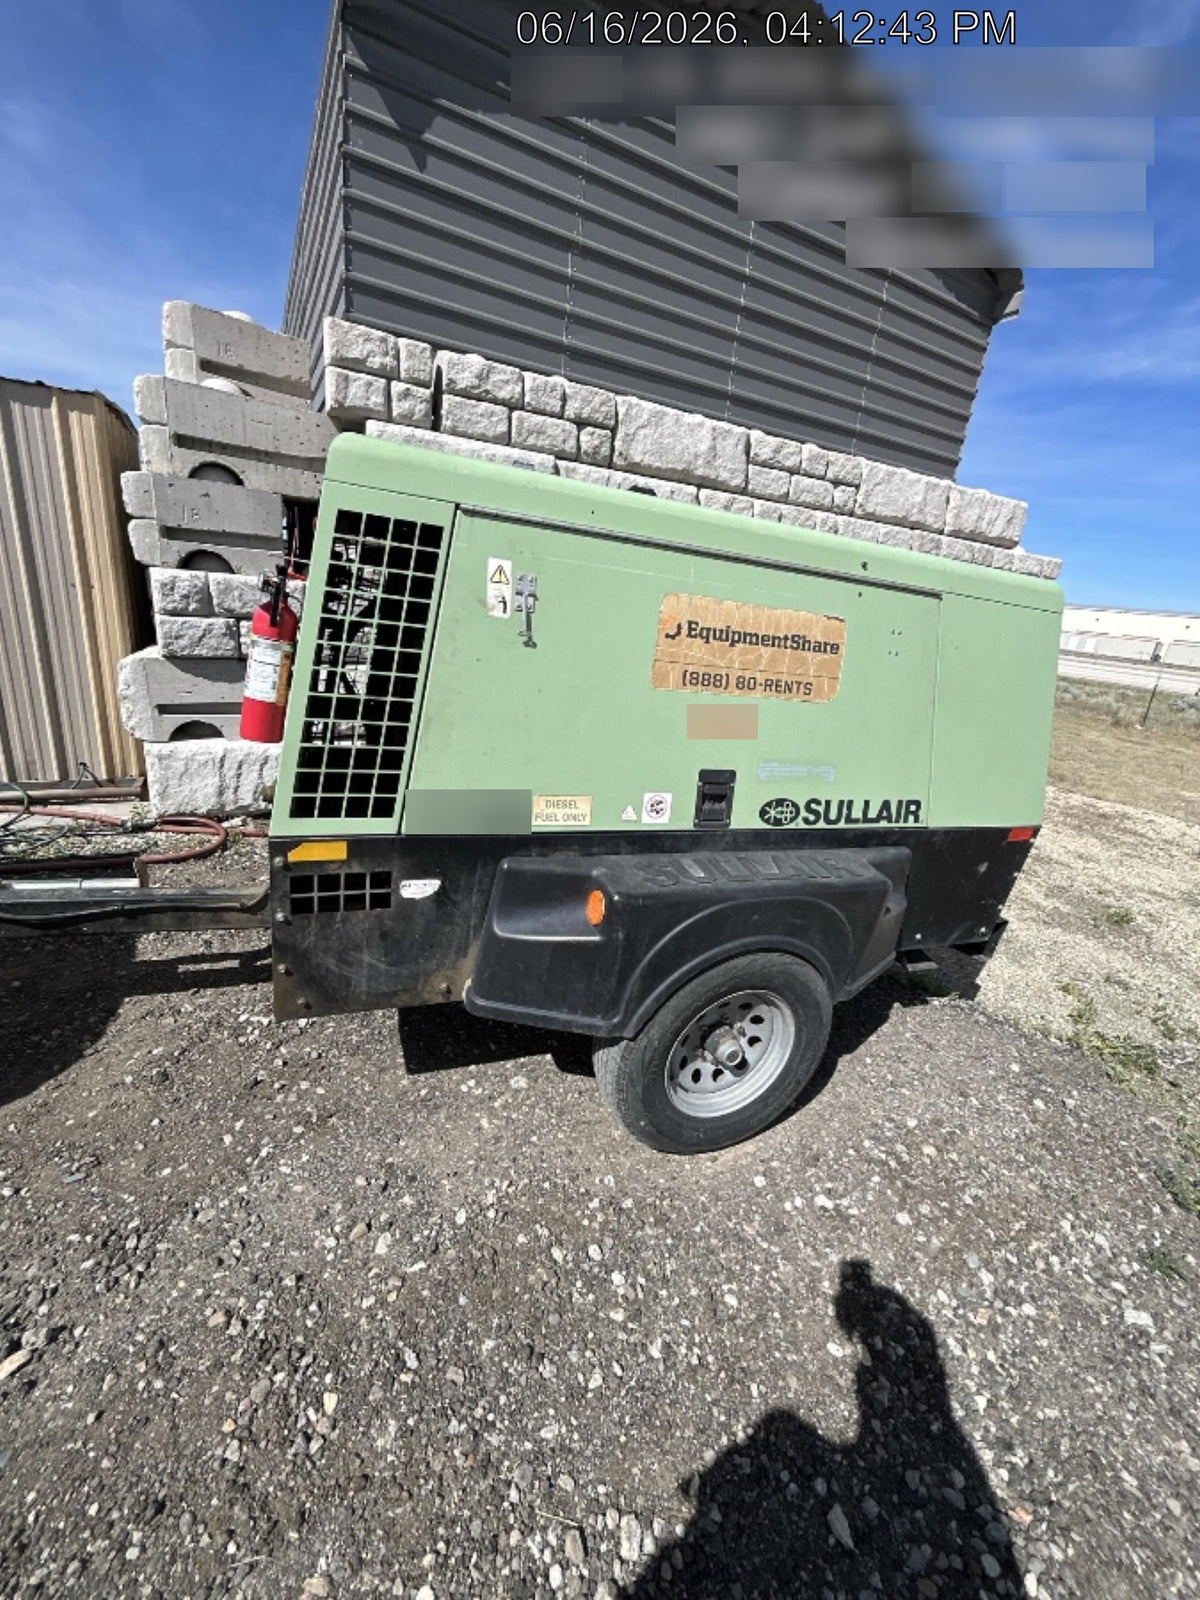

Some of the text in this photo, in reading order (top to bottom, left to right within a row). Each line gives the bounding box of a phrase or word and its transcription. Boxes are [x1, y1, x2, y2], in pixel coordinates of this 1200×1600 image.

[686, 620, 840, 655] EquipmentShare
[682, 669, 813, 696] (888) 80-RENTS
[535, 812, 588, 823] FUEL ONLY
[545, 799, 579, 810] DIESEL
[802, 798, 922, 826] SULLAIR
